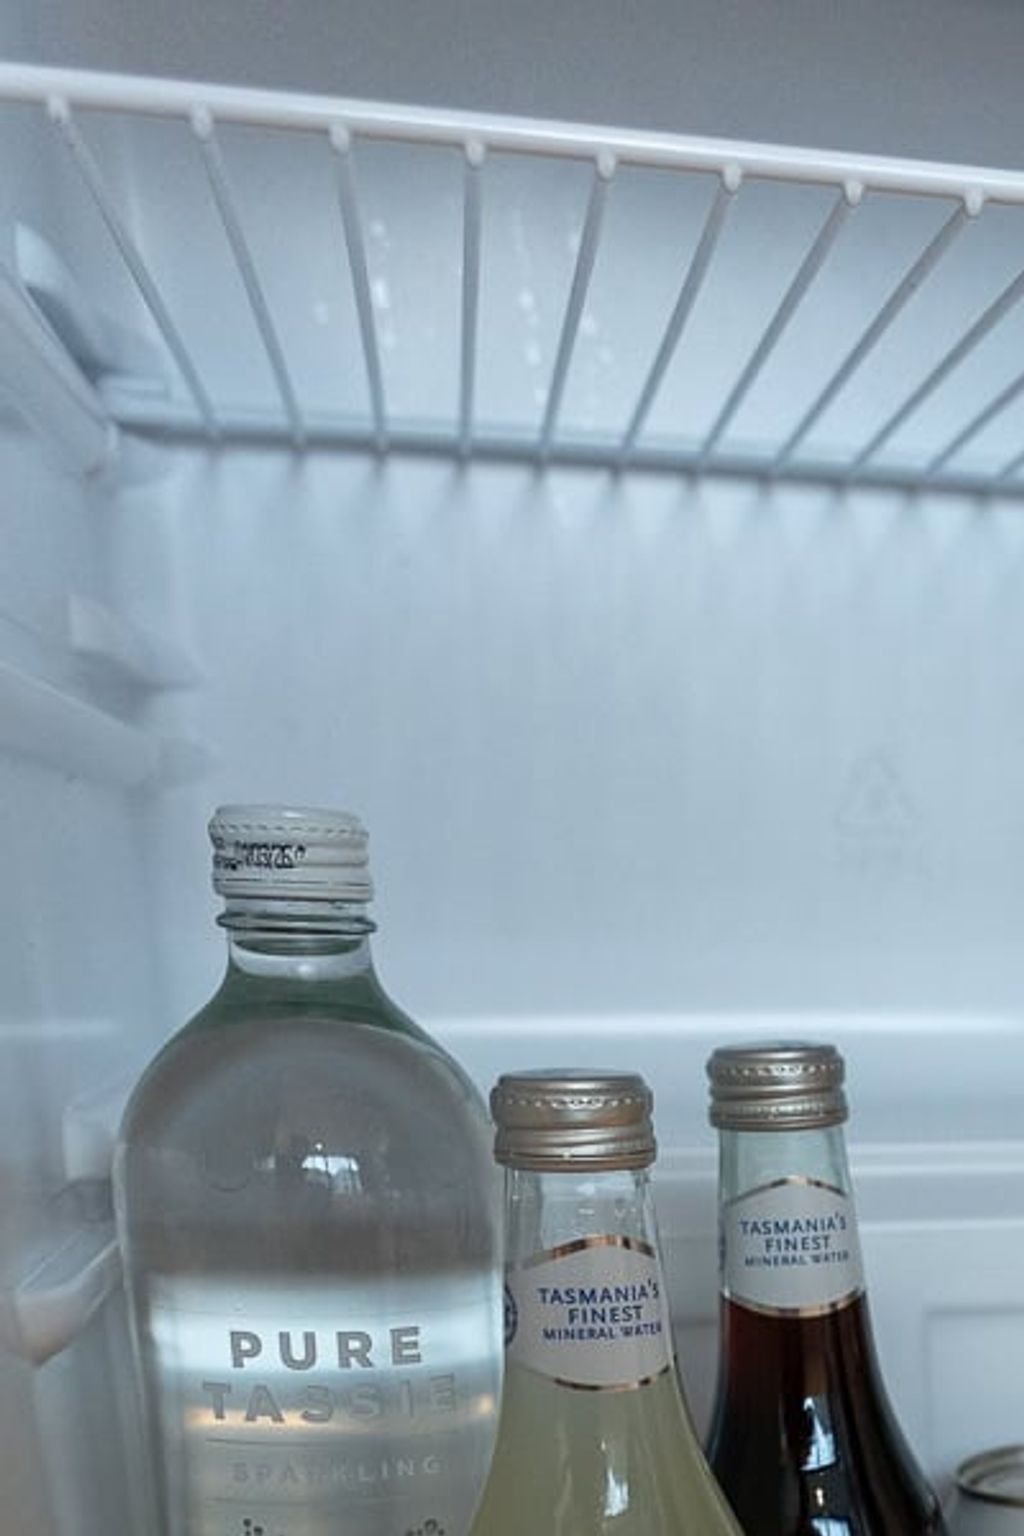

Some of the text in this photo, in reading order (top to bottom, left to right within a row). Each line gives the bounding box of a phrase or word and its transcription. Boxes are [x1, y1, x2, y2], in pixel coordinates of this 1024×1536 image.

[739, 1211, 847, 1235] TASMANIA'S
[765, 1236, 830, 1253] FINEST
[744, 1250, 849, 1267] MINERAL WATER
[537, 1279, 660, 1305] TASMANIA'S
[568, 1306, 643, 1325] FINEST
[543, 1321, 662, 1342] MINERAL WATER
[229, 1325, 423, 1371] PURE
[202, 1373, 458, 1423] TASSIE
